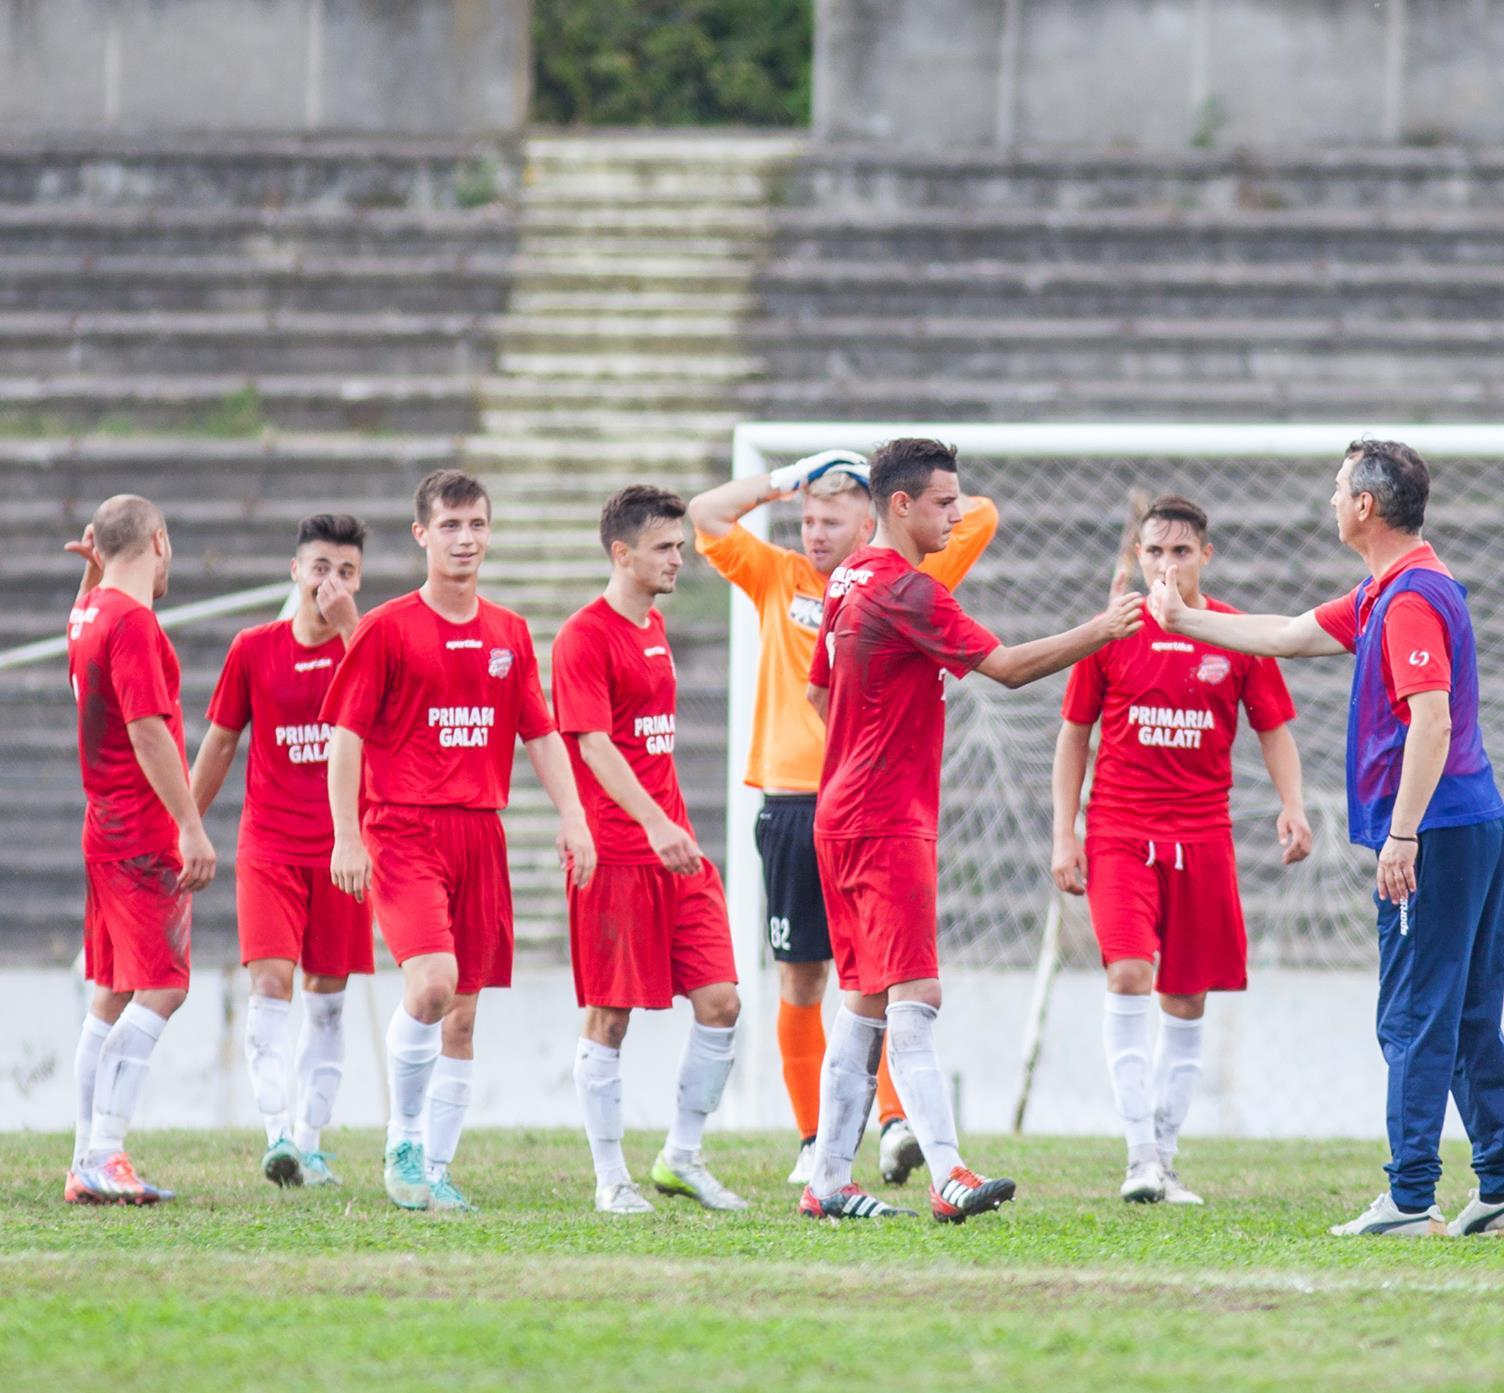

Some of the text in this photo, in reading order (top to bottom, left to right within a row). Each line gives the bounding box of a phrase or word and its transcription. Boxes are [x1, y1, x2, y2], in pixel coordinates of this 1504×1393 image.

[1128, 705, 1215, 730] PRIMARIA
[275, 723, 333, 746] PRIMA
[1138, 726, 1201, 749] GALATI
[288, 743, 330, 764] GALA
[770, 916, 792, 950] 82
